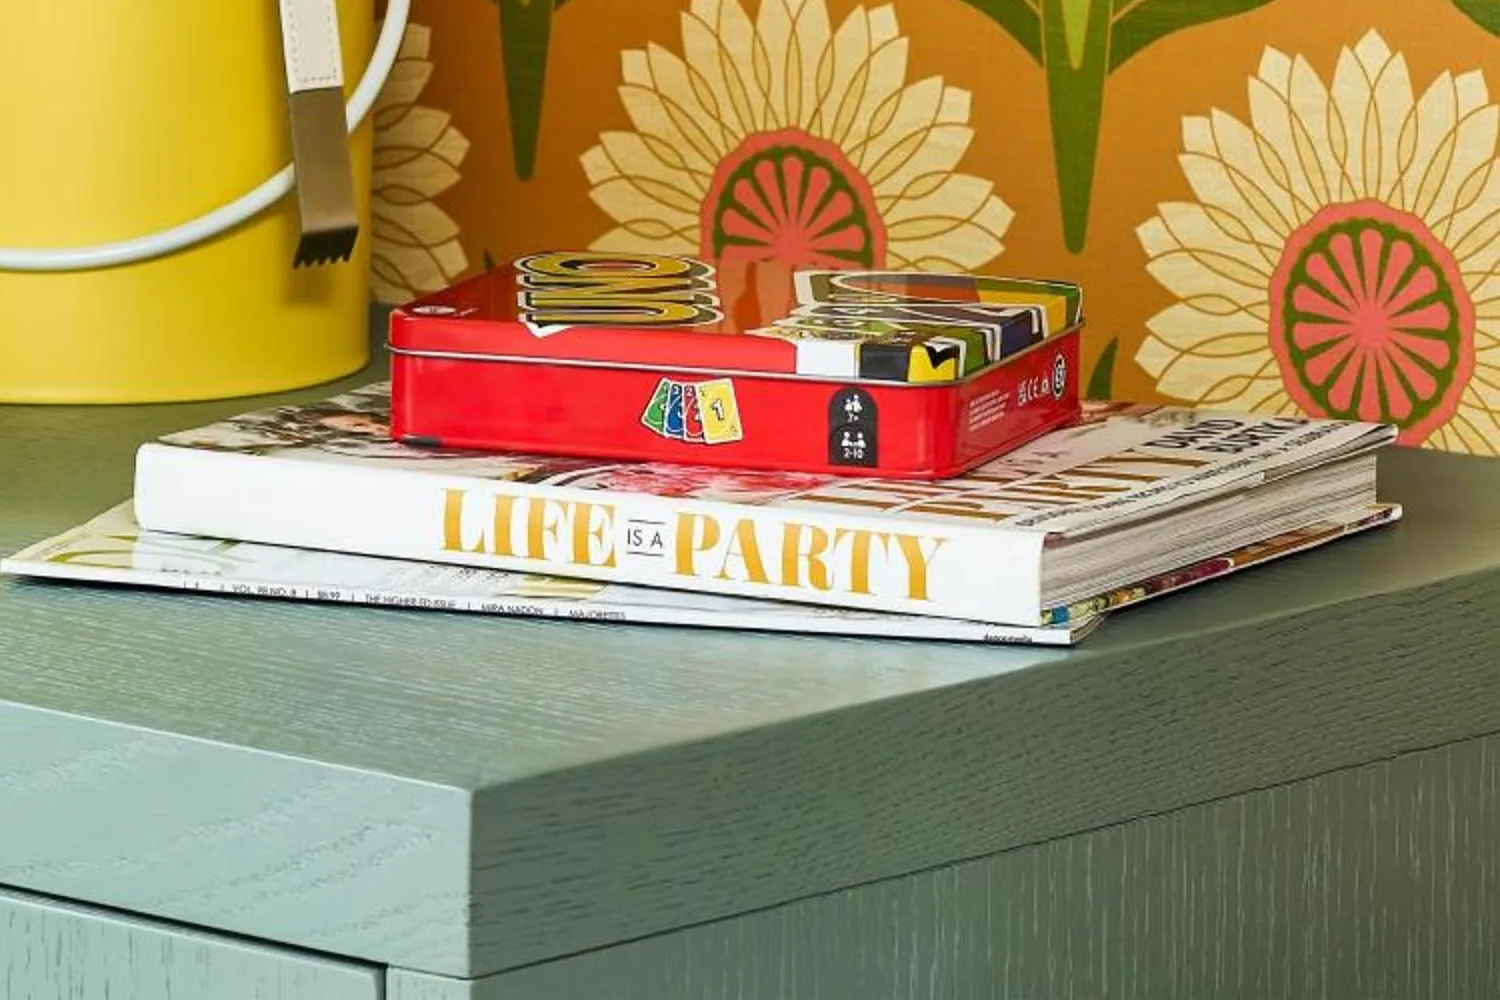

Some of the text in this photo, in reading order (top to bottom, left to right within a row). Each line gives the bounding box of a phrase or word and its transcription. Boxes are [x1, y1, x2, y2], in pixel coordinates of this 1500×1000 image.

[711, 398, 725, 421] 1
[440, 487, 949, 602] LIFE IS A PARTY
